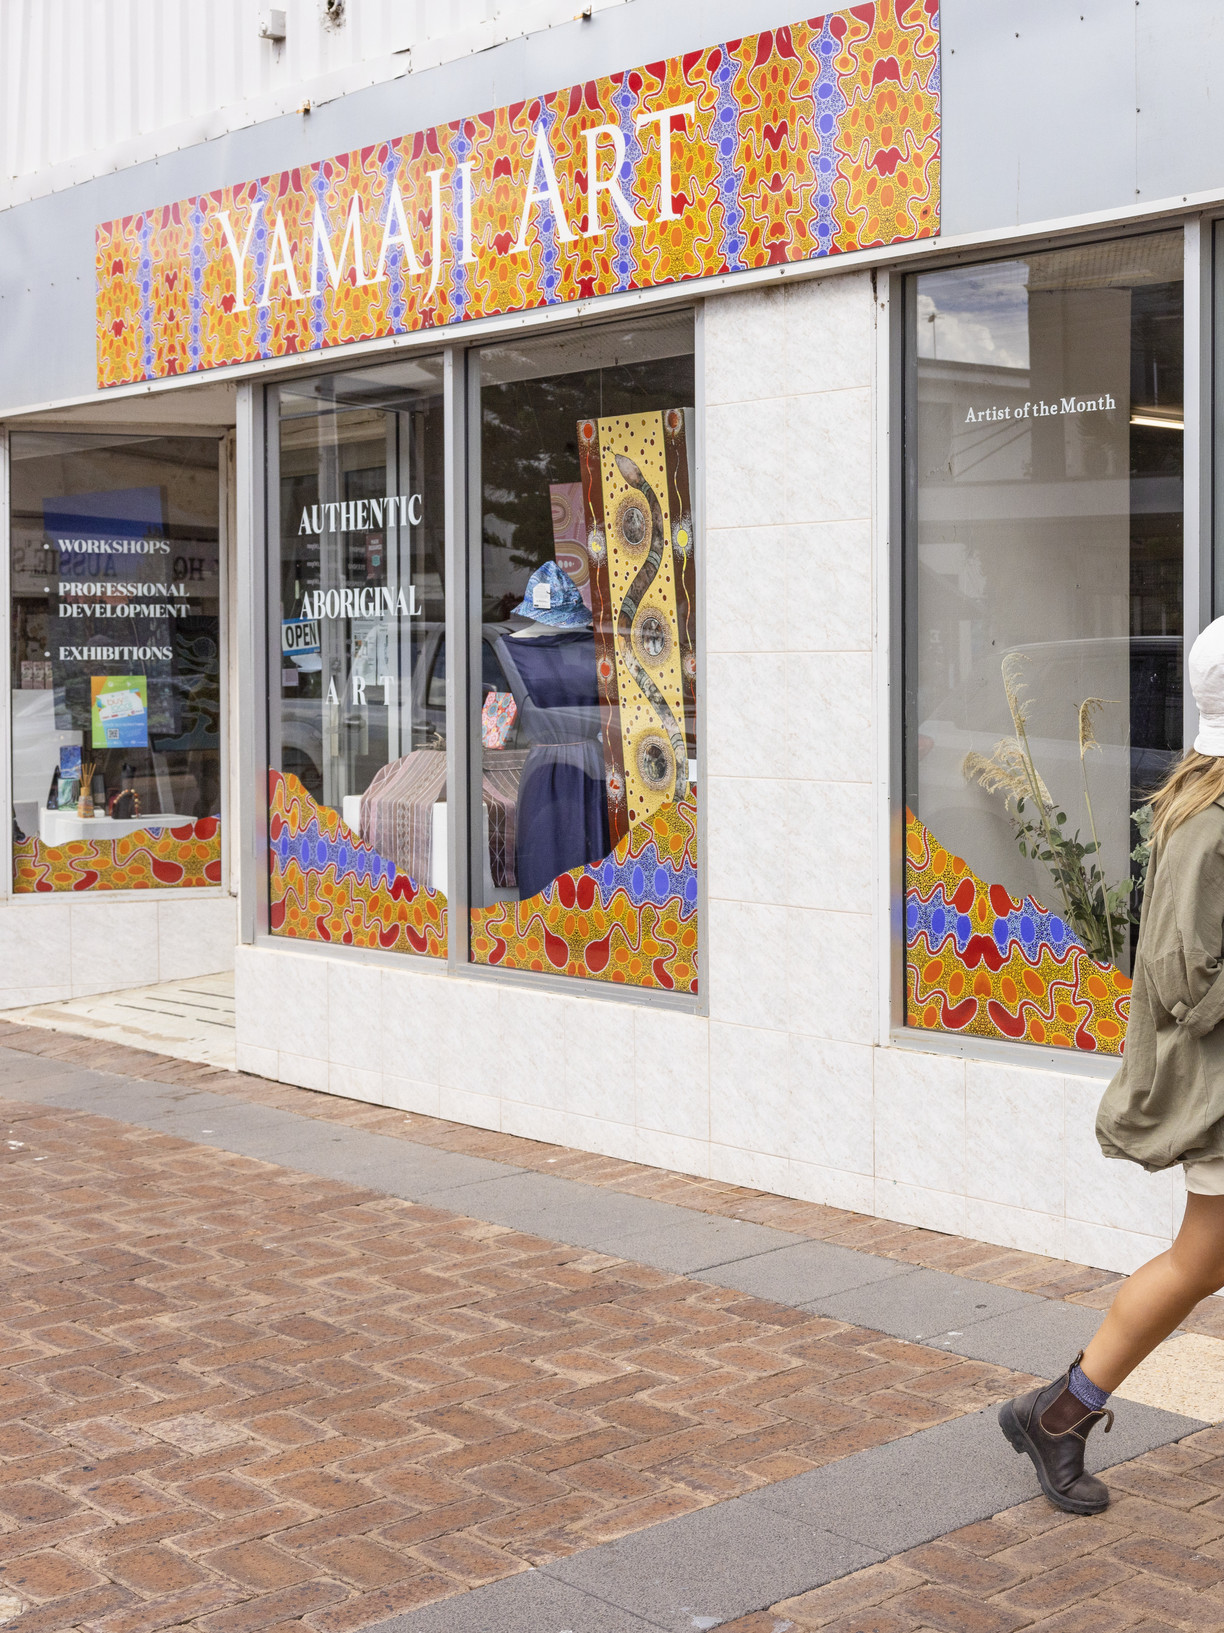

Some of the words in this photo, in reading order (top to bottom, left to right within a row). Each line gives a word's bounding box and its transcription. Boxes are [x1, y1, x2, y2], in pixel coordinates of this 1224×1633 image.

[214, 159, 478, 313] YAMAJI
[508, 100, 696, 254] ART
[963, 405, 1010, 423] Artist
[1013, 402, 1031, 419] of
[1032, 400, 1058, 417] the
[1059, 393, 1116, 415] Month
[298, 494, 422, 535] AUTHENTIC
[58, 539, 171, 555] WORKSHOPS
[58, 582, 190, 598] PROFESSIONAL
[300, 585, 422, 620] ABORIGINAL
[58, 603, 190, 619] DEVELOPMENT
[285, 622, 317, 648] OPEN
[59, 646, 173, 661] EXHIBITIONS
